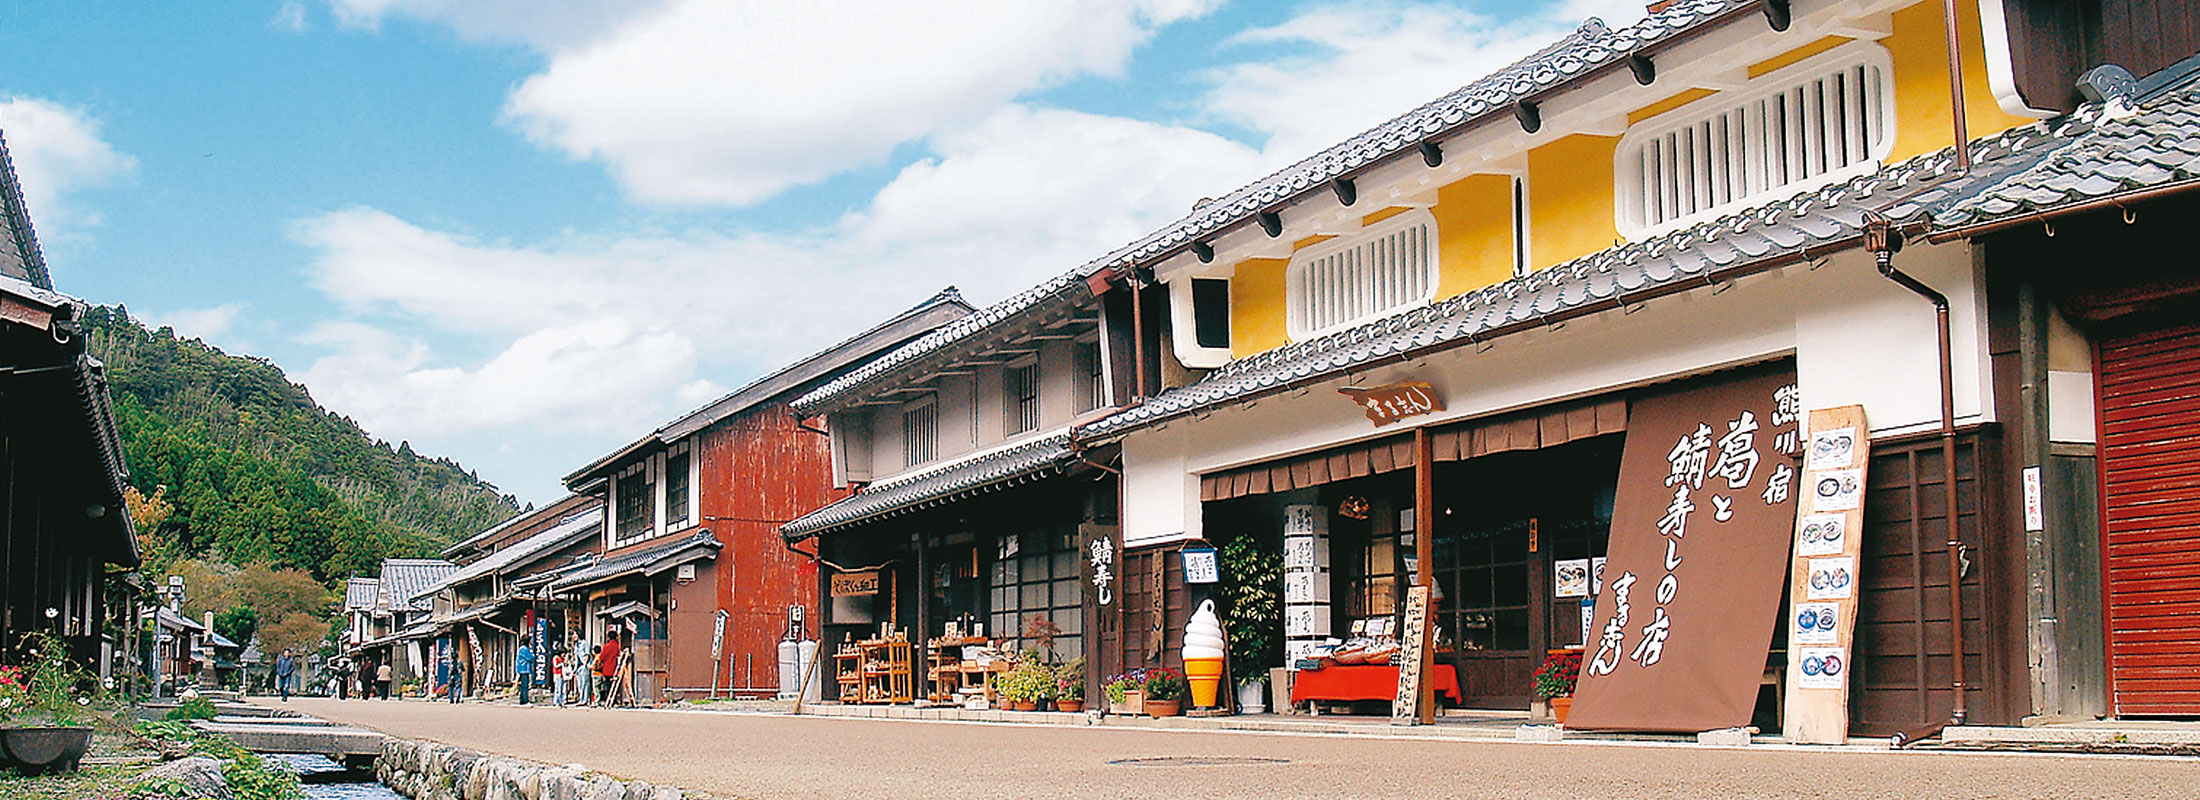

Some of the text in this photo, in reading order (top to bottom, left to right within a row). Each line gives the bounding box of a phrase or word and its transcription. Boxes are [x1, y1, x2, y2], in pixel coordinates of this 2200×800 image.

[1707, 410, 1760, 522] 葛と
[1761, 383, 1799, 504] 熊川宿
[1090, 535, 1114, 605] 鯖寿し
[1630, 422, 1713, 668] 鯖寿しの店
